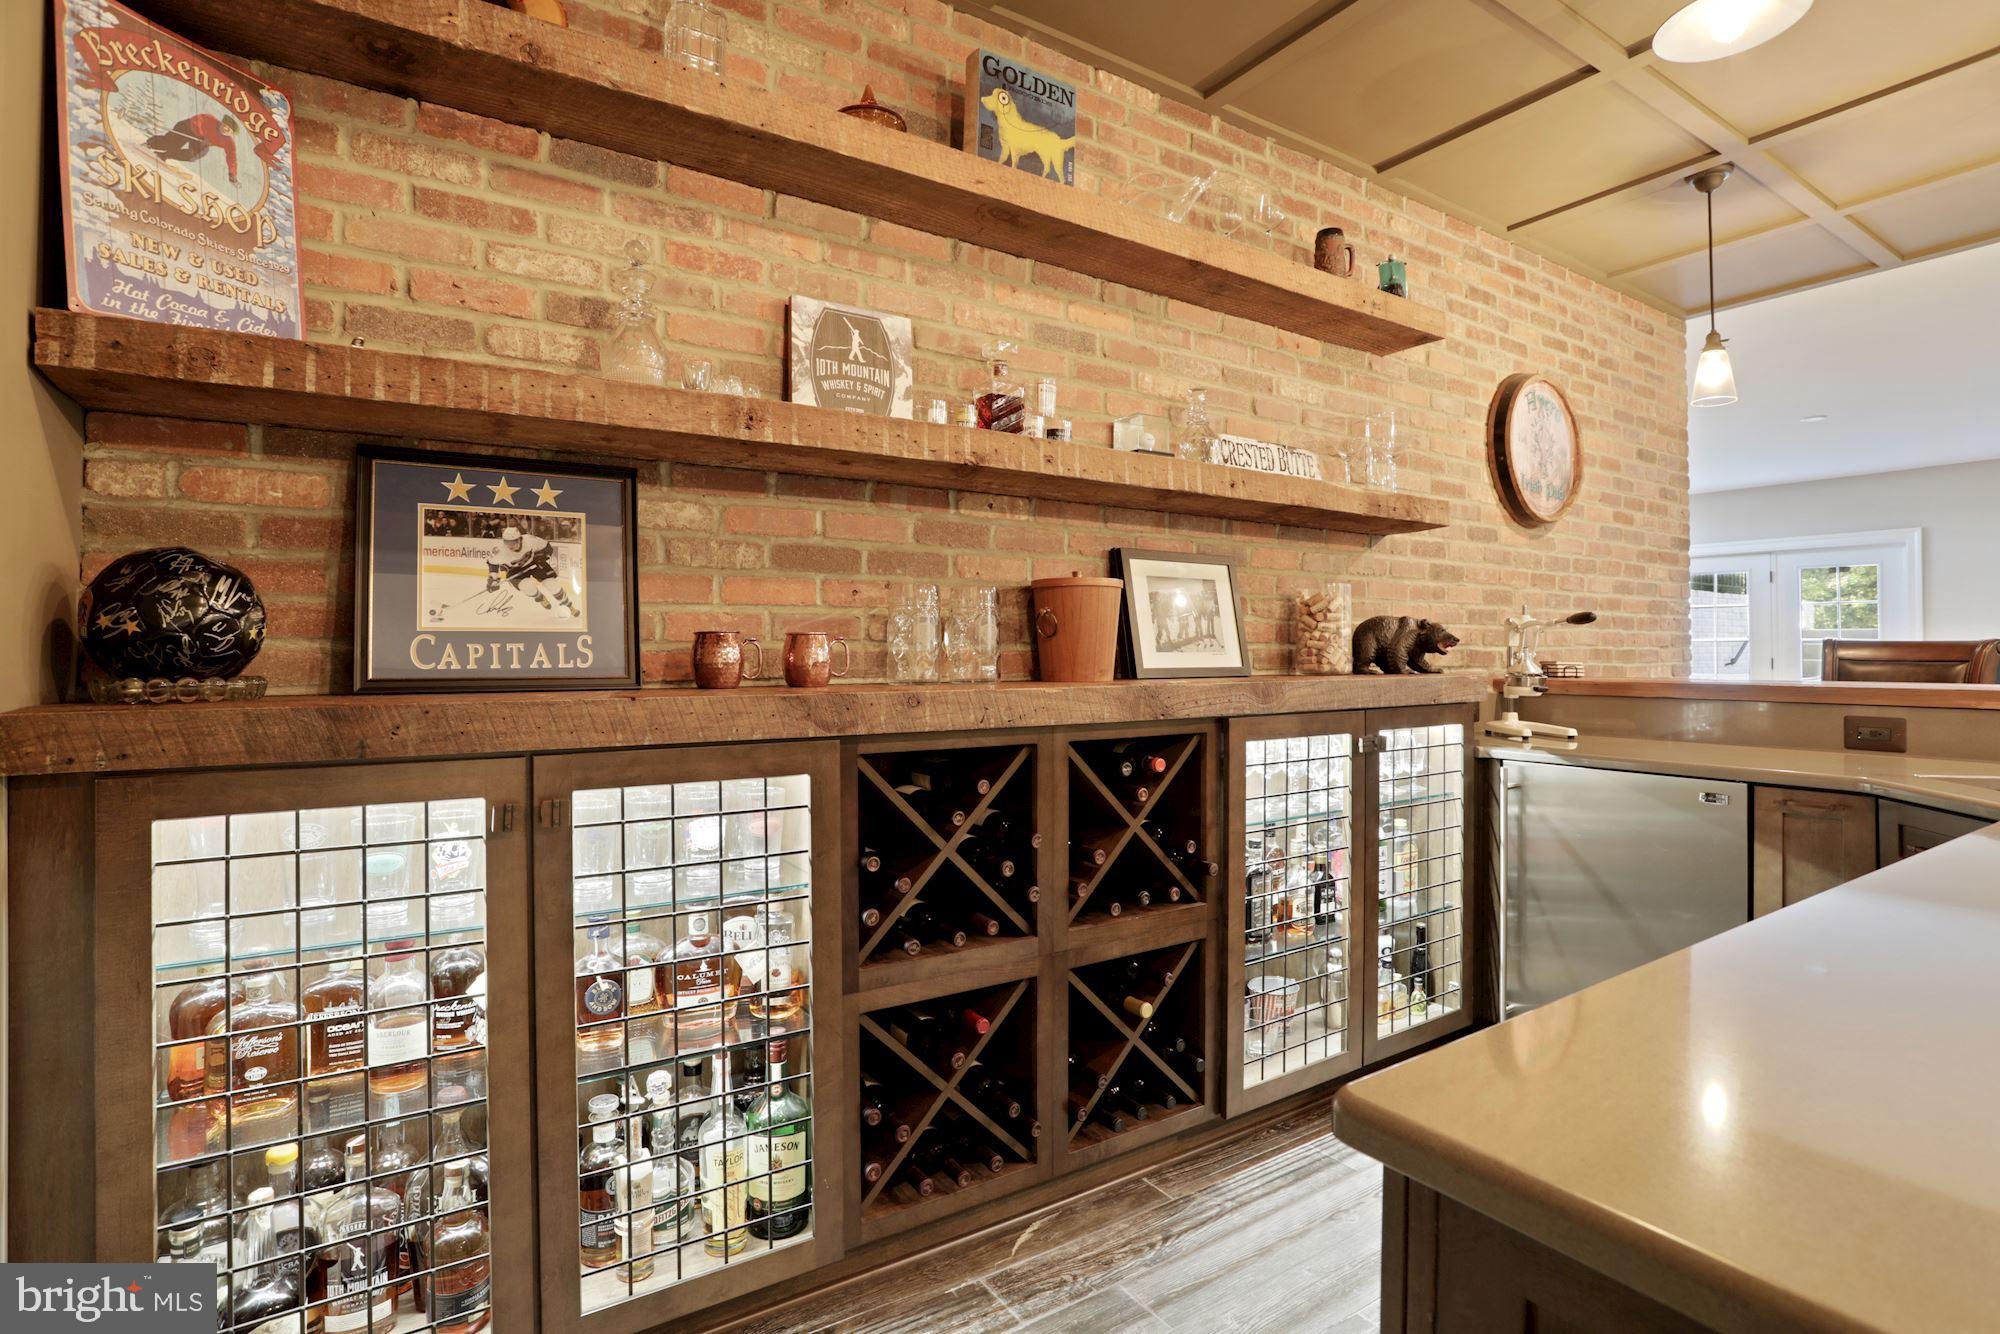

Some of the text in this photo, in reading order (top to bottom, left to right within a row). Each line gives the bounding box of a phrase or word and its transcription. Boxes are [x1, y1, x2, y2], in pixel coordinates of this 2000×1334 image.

[80, 29, 280, 143] Breckenridge
[982, 55, 1074, 108] GOLDEN
[95, 148, 278, 248] SKI SHOP
[82, 191, 138, 221] Serving
[139, 210, 196, 241] Colorado
[197, 232, 236, 257] Skiers
[236, 248, 269, 268] Since
[98, 241, 287, 313] SALES & RENTALS
[130, 231, 260, 286] NEW & USED
[100, 293, 159, 320] in the
[112, 279, 150, 302] Hot
[155, 293, 208, 319] Cocoa
[236, 317, 278, 338] Cider
[820, 378, 854, 391] WHISKEY
[863, 383, 886, 400] SPIRIT
[835, 392, 871, 403] COMPANY
[842, 362, 890, 388] MOUNTAIN
[1220, 438, 1316, 478] CRESTED BUTTE
